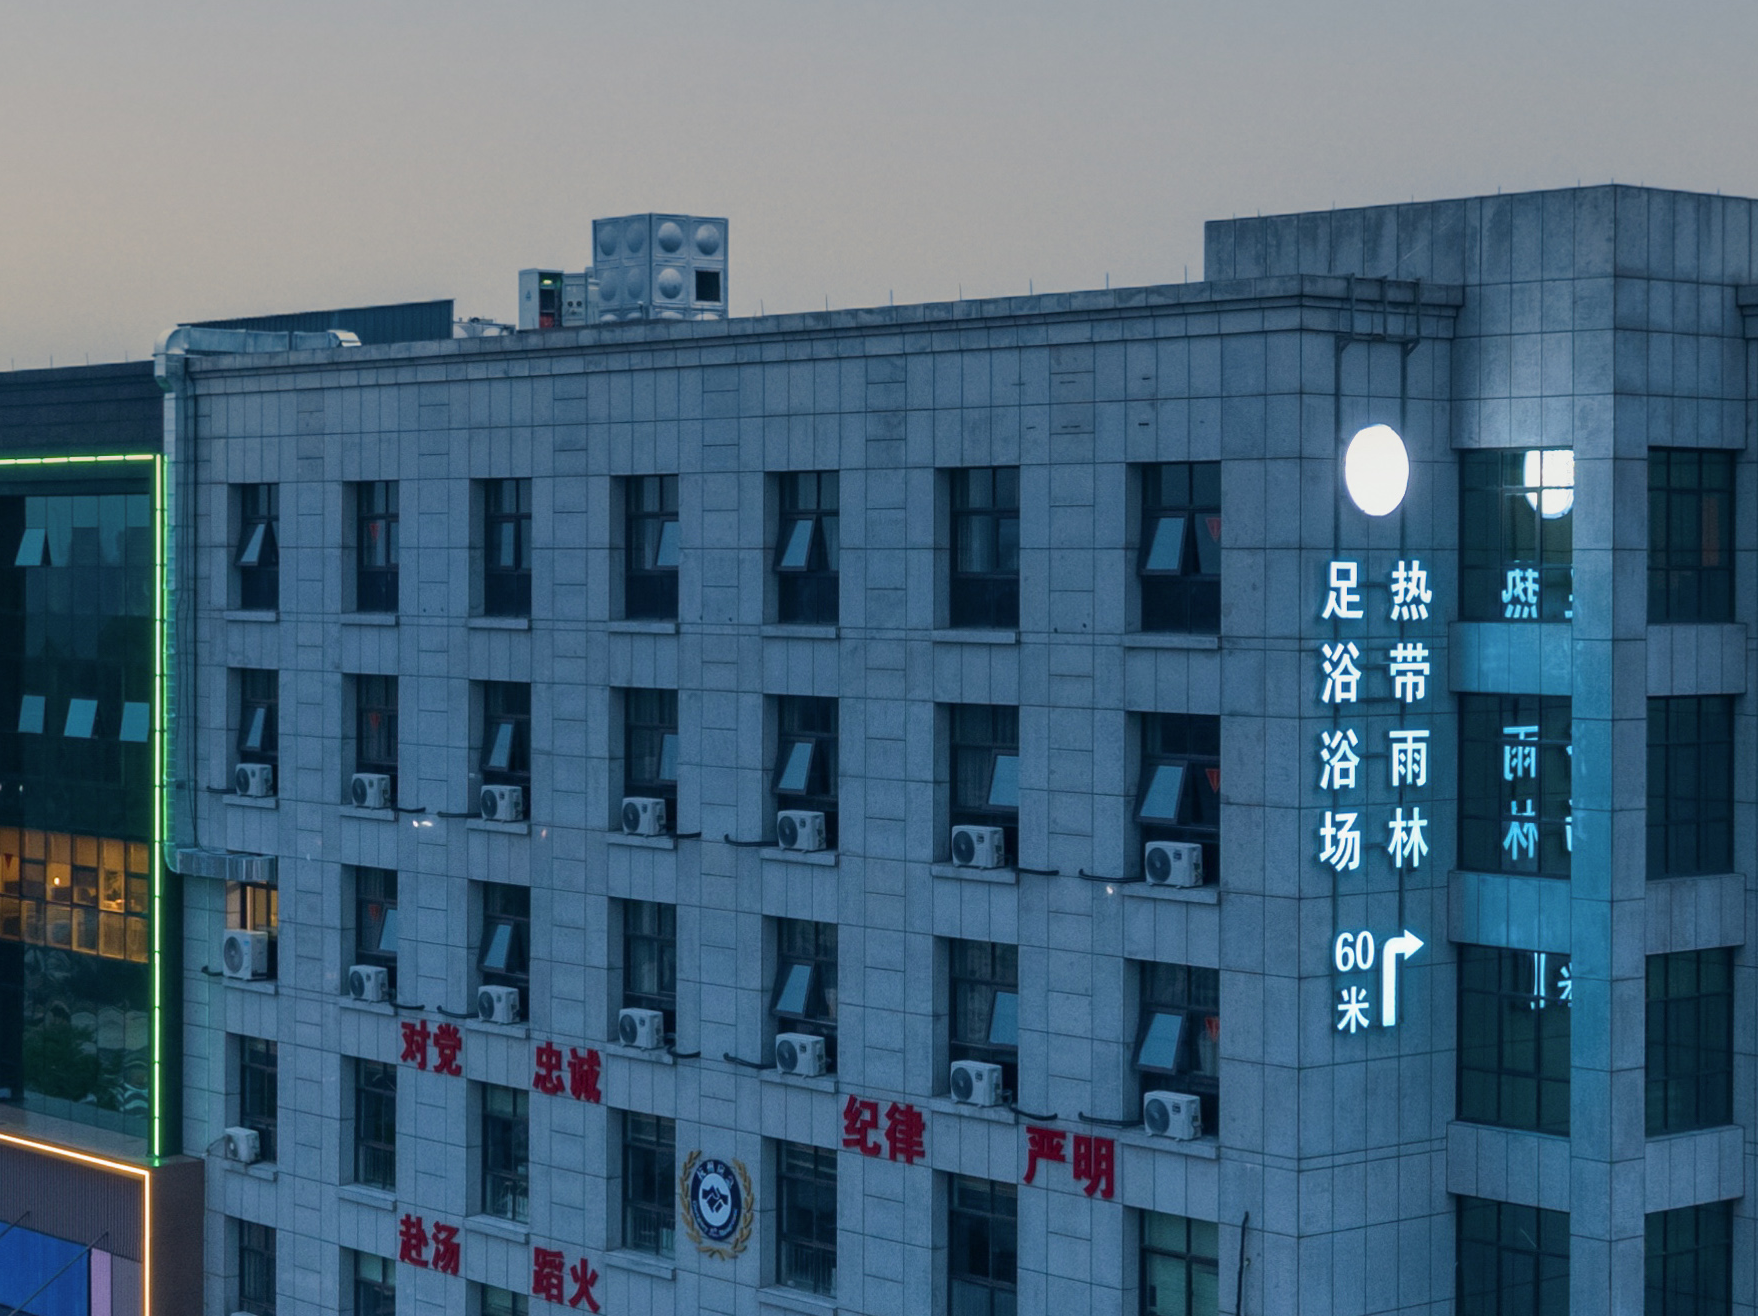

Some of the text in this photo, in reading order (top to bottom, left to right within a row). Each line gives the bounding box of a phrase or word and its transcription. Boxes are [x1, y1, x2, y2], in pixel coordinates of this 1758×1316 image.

[1319, 561, 1364, 871] 足浴浴场
[1388, 560, 1432, 868] 热带雨林
[1335, 930, 1375, 972] 60
[1337, 986, 1369, 1033] 米
[402, 1021, 600, 1102] 对党 忠诚
[843, 1096, 1114, 1198] 纪律 严明
[400, 1215, 599, 1313] 赴汤 蹈火
